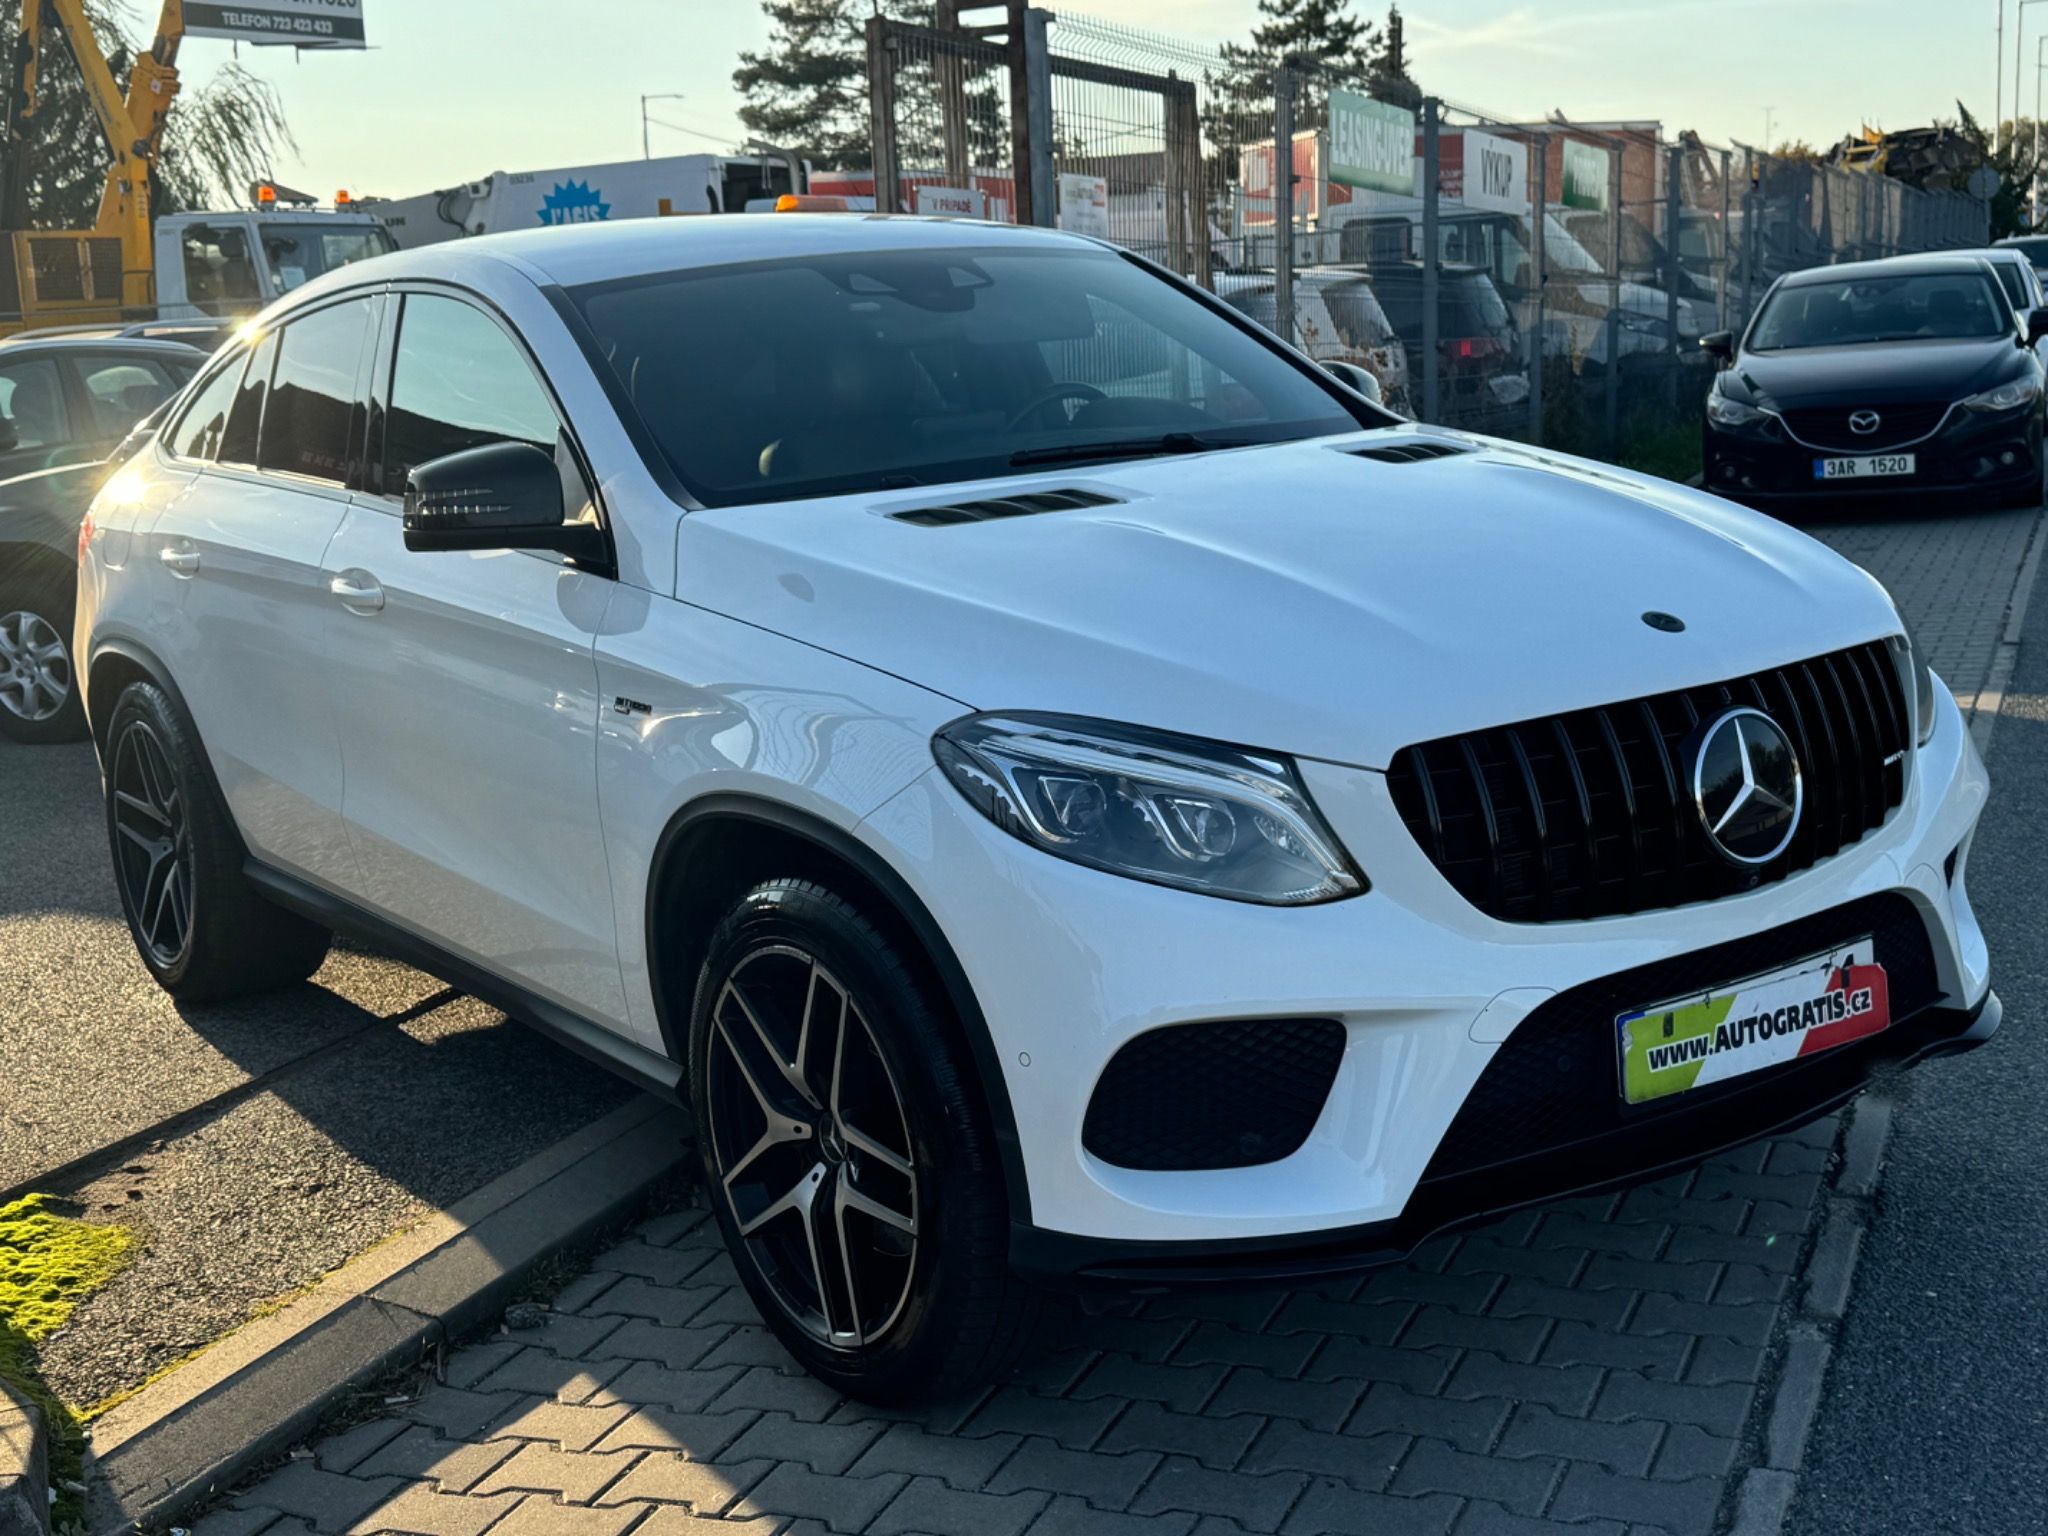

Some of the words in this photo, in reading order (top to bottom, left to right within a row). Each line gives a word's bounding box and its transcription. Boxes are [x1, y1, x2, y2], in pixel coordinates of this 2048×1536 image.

[221, 11, 271, 28] TELEFON
[272, 16, 291, 30] 723
[293, 18, 312, 32] 423
[313, 20, 333, 34] 433
[1480, 138, 1513, 198] VÝKUP
[1827, 460, 1856, 476] 3AR
[1869, 456, 1908, 473] 1520
[1648, 989, 1871, 1070] www.AUTOGRATIS.cz
